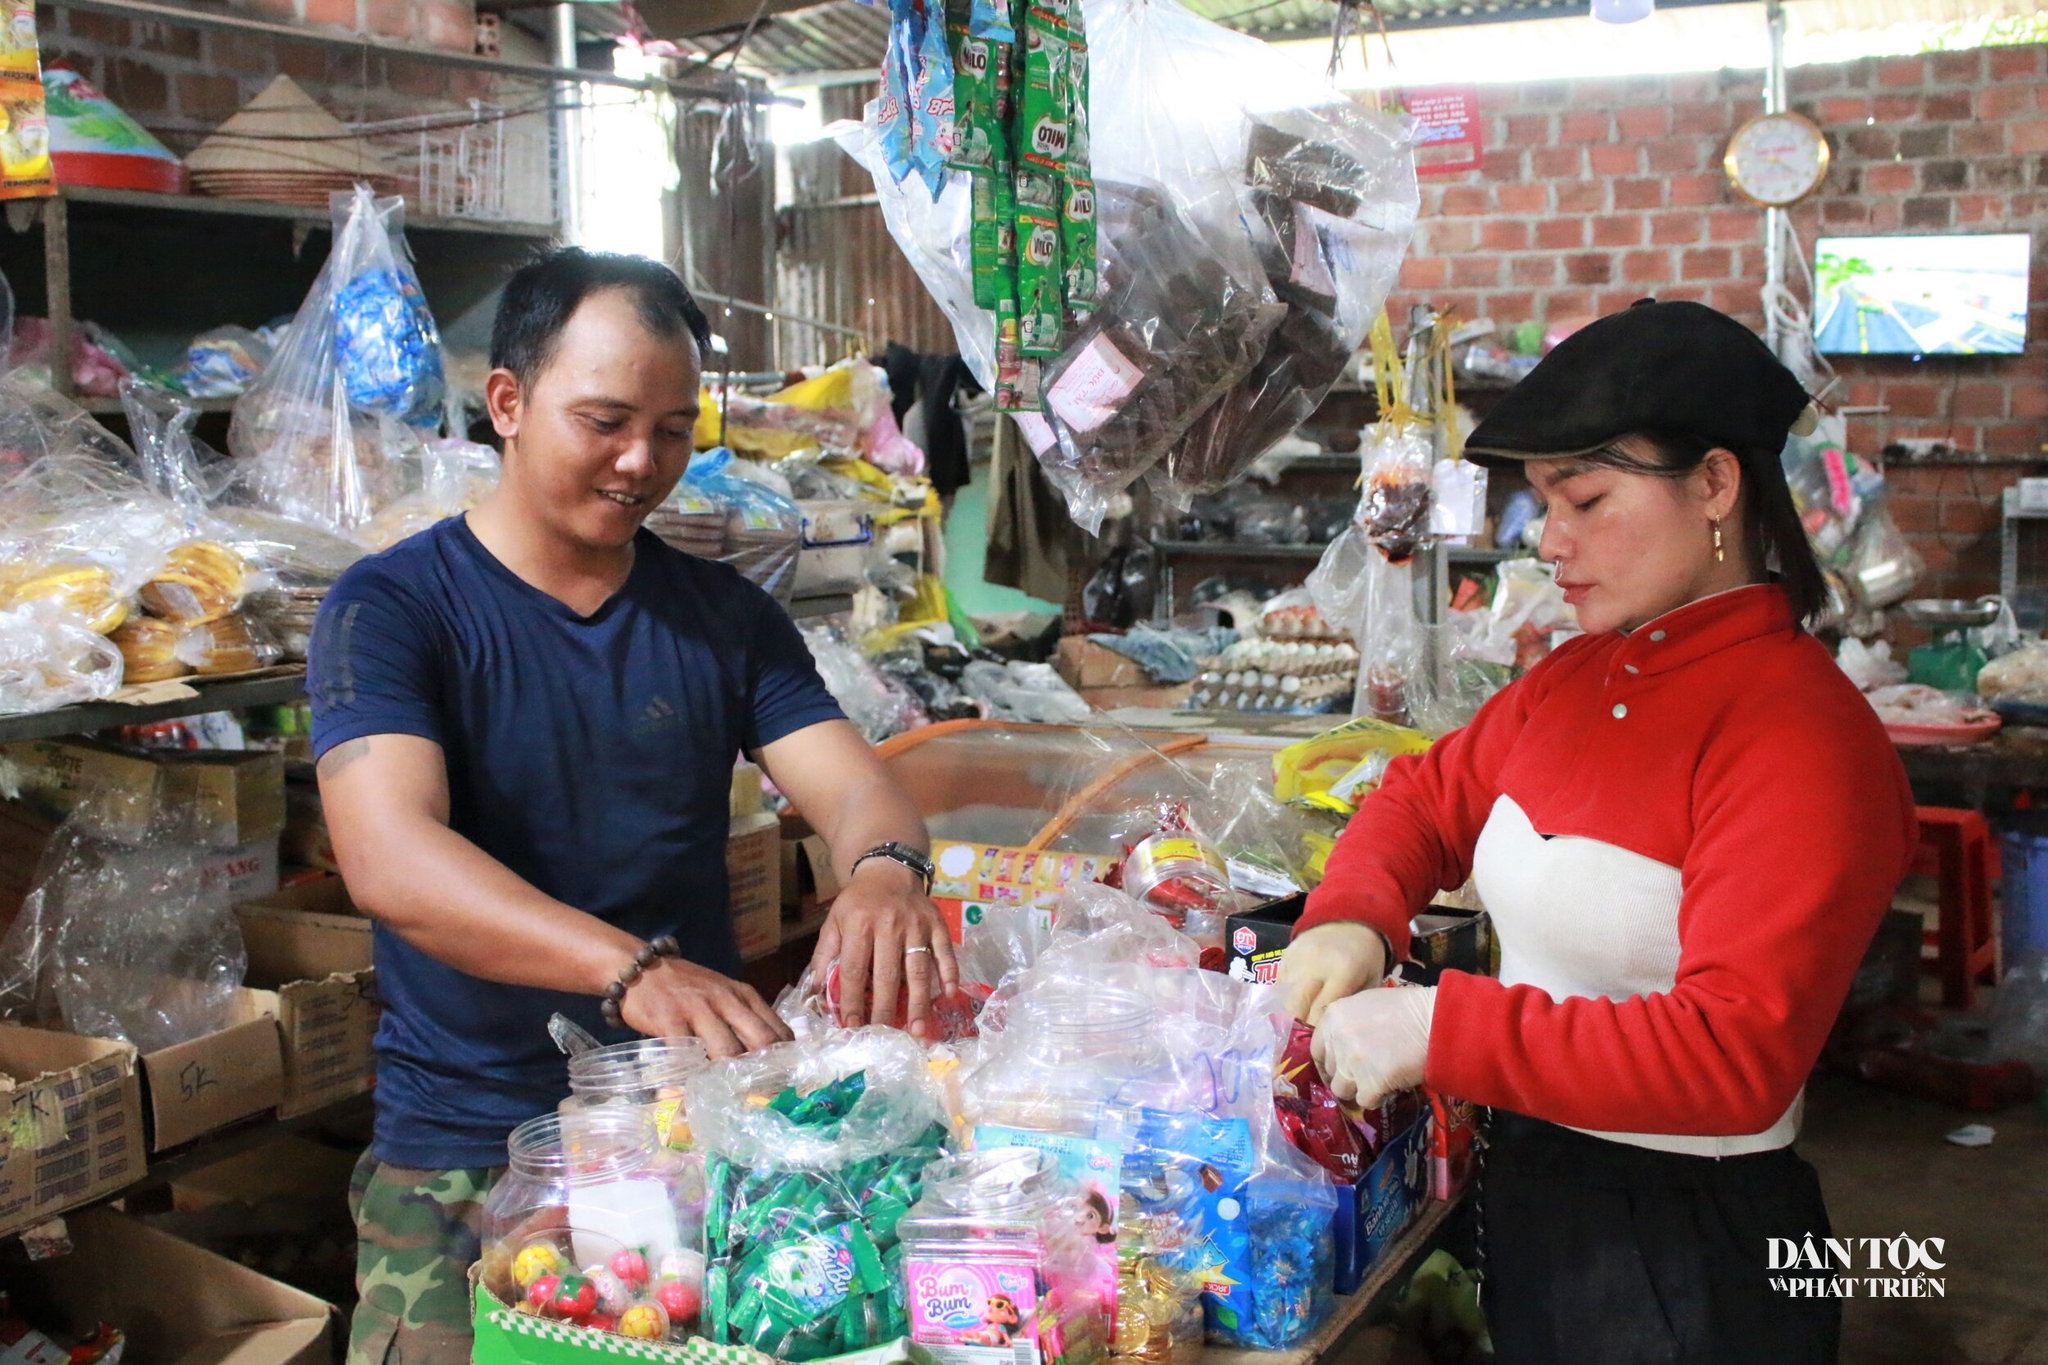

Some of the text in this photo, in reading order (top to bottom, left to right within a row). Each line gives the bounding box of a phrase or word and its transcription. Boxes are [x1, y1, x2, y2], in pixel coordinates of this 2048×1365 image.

[1038, 125, 1067, 149] MILO
[919, 1276, 969, 1299] Bum
[926, 1296, 972, 1319] Bum
